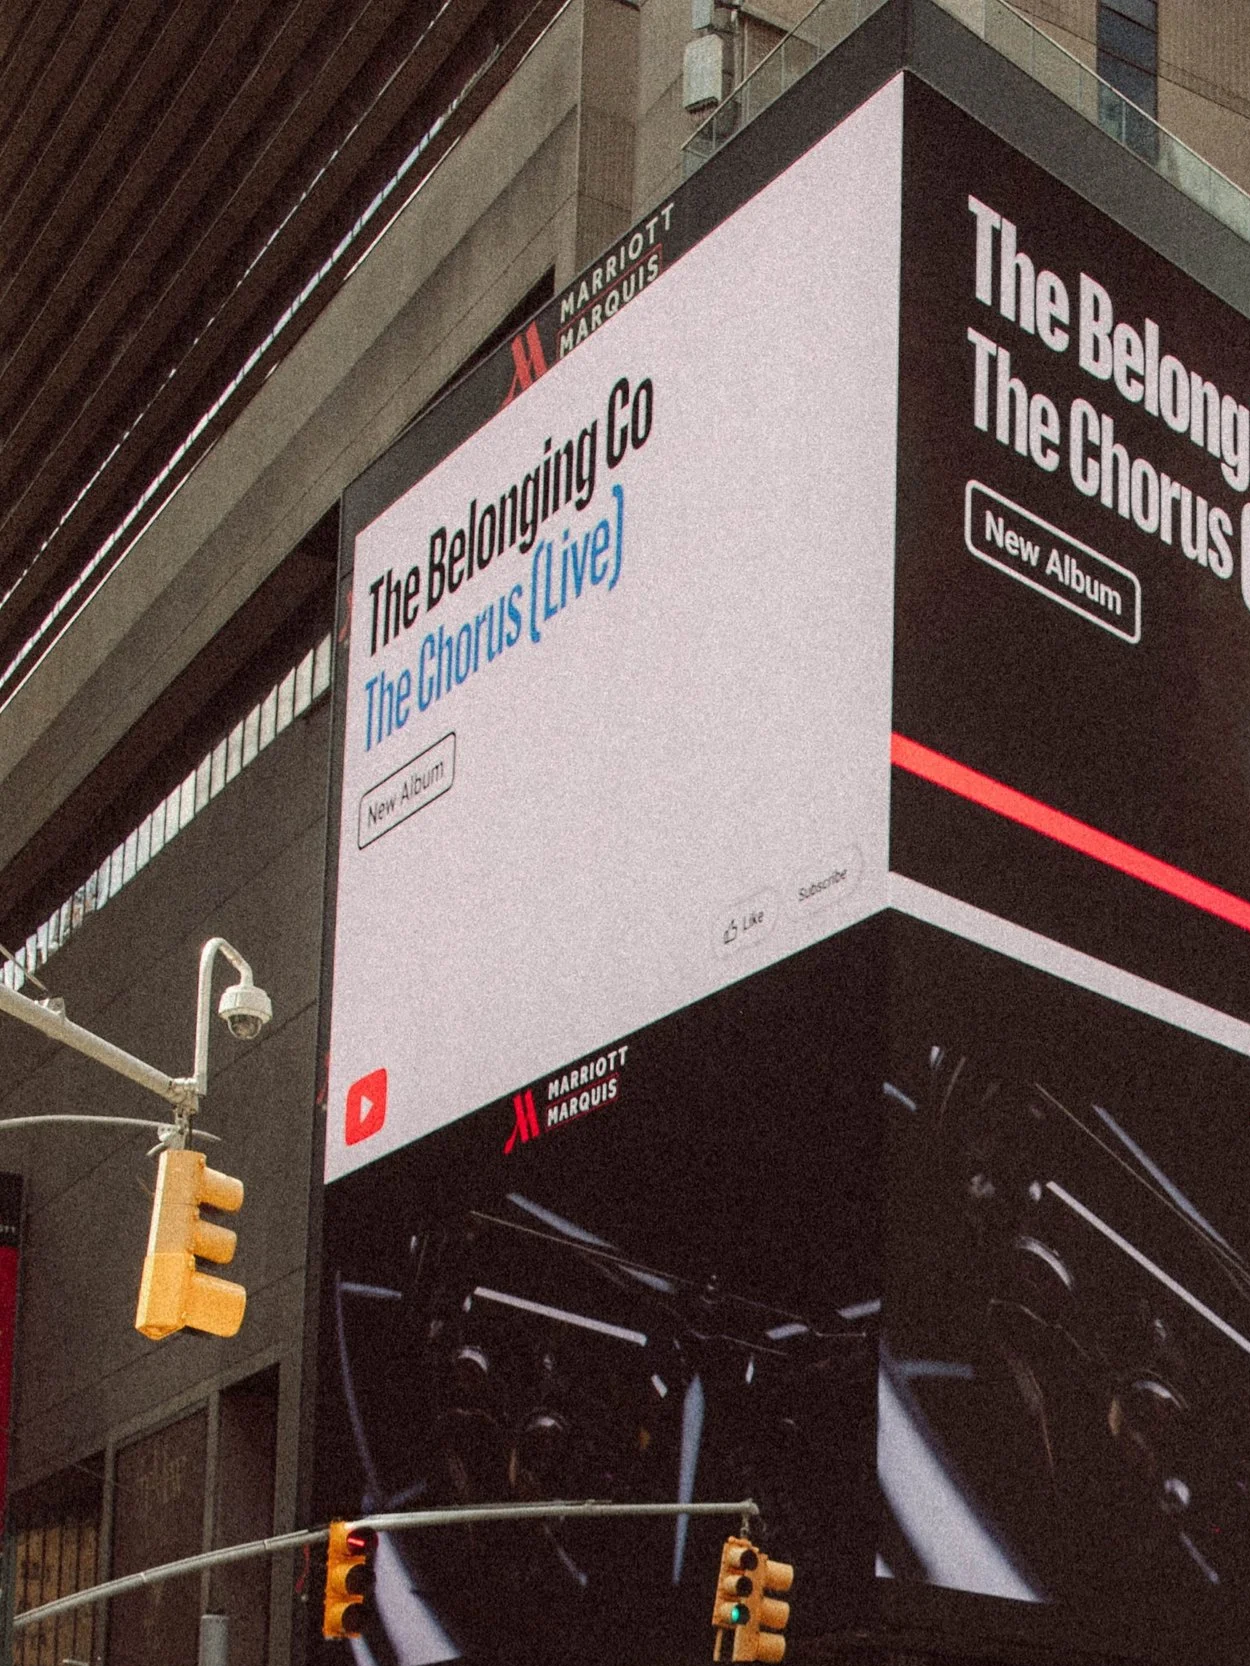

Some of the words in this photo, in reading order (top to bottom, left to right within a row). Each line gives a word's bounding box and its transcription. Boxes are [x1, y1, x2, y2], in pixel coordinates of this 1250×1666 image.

[559, 203, 676, 323] MARRIOTT
[559, 254, 661, 359] MARQUIS
[968, 195, 1070, 353] The
[967, 328, 1061, 473] The
[1069, 397, 1234, 581] Chorus
[368, 566, 421, 658] The
[425, 418, 599, 614] Belonging
[605, 375, 655, 471] Co
[984, 509, 1040, 569] New
[1045, 547, 1122, 616] Album
[363, 666, 411, 753] The
[417, 580, 523, 712] Chorus
[529, 483, 625, 645] (Live)
[367, 790, 399, 830] New
[399, 759, 446, 808] Album
[741, 908, 765, 932] Like
[797, 866, 849, 902] Subscribe
[546, 1077, 619, 1128] MARQUIS
[547, 1045, 630, 1101] MARRIOTT
